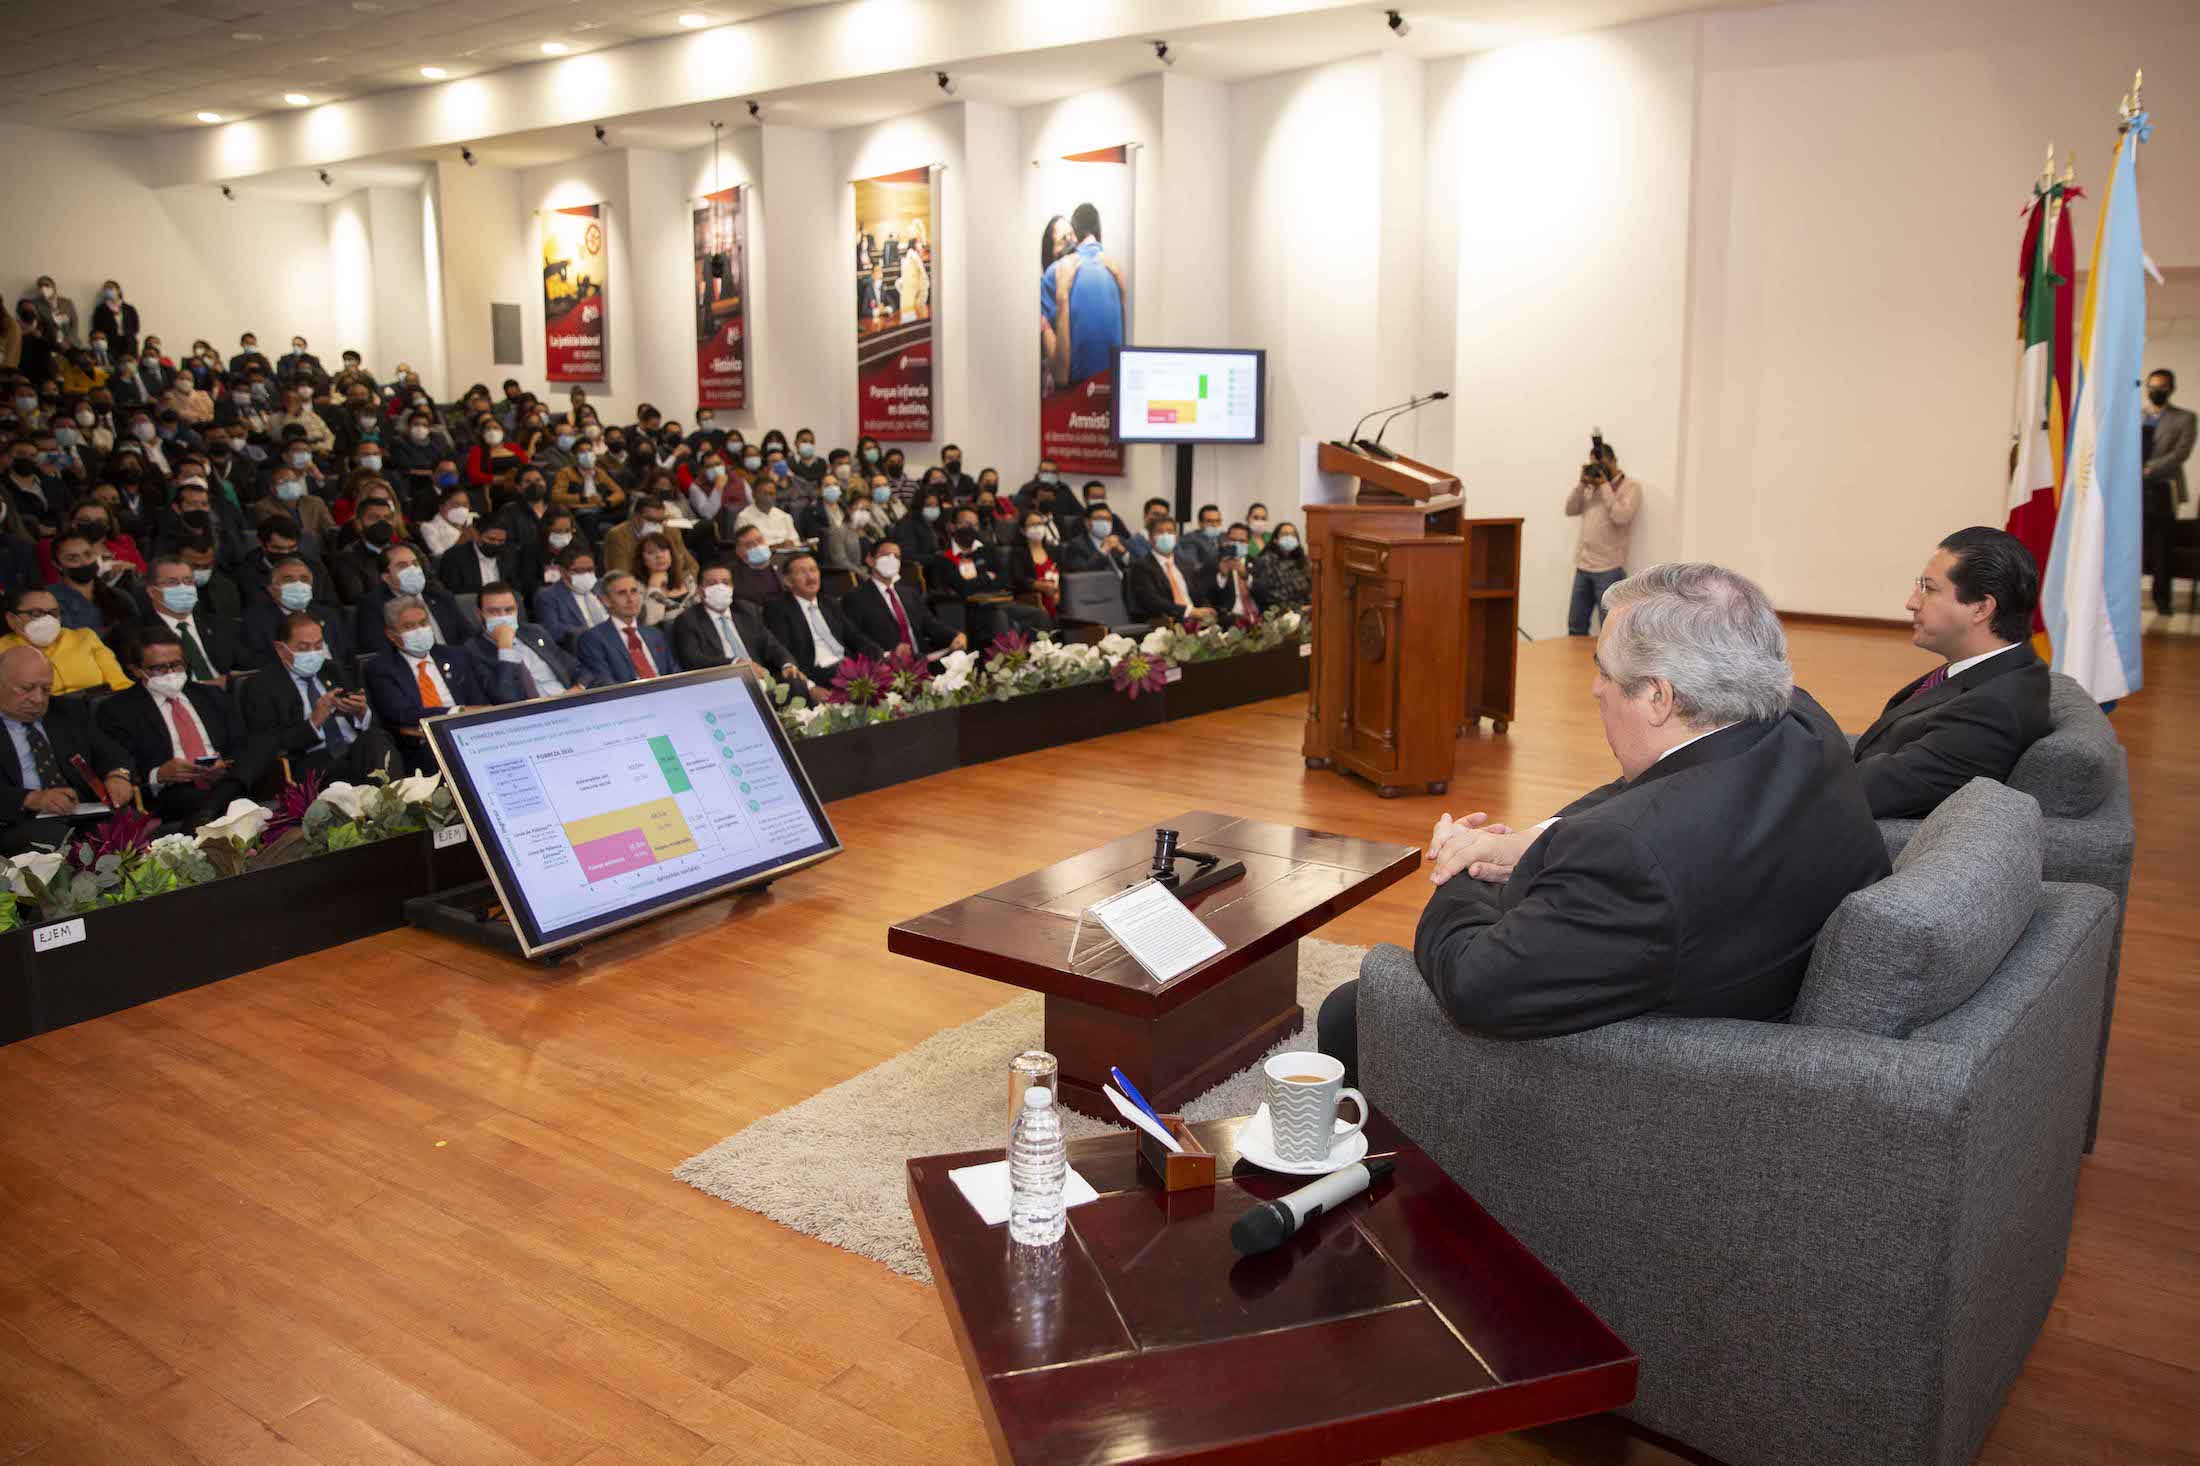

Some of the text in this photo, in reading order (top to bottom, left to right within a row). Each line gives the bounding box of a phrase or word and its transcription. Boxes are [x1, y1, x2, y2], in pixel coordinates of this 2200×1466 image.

[869, 384, 929, 401] Porque infancia
[888, 404, 898, 415] es
[535, 750, 560, 760] POBREZA
[439, 829, 461, 841] EJEM
[656, 870, 680, 882] derechos
[680, 864, 700, 874] sociales
[40, 925, 71, 943] EJEM
